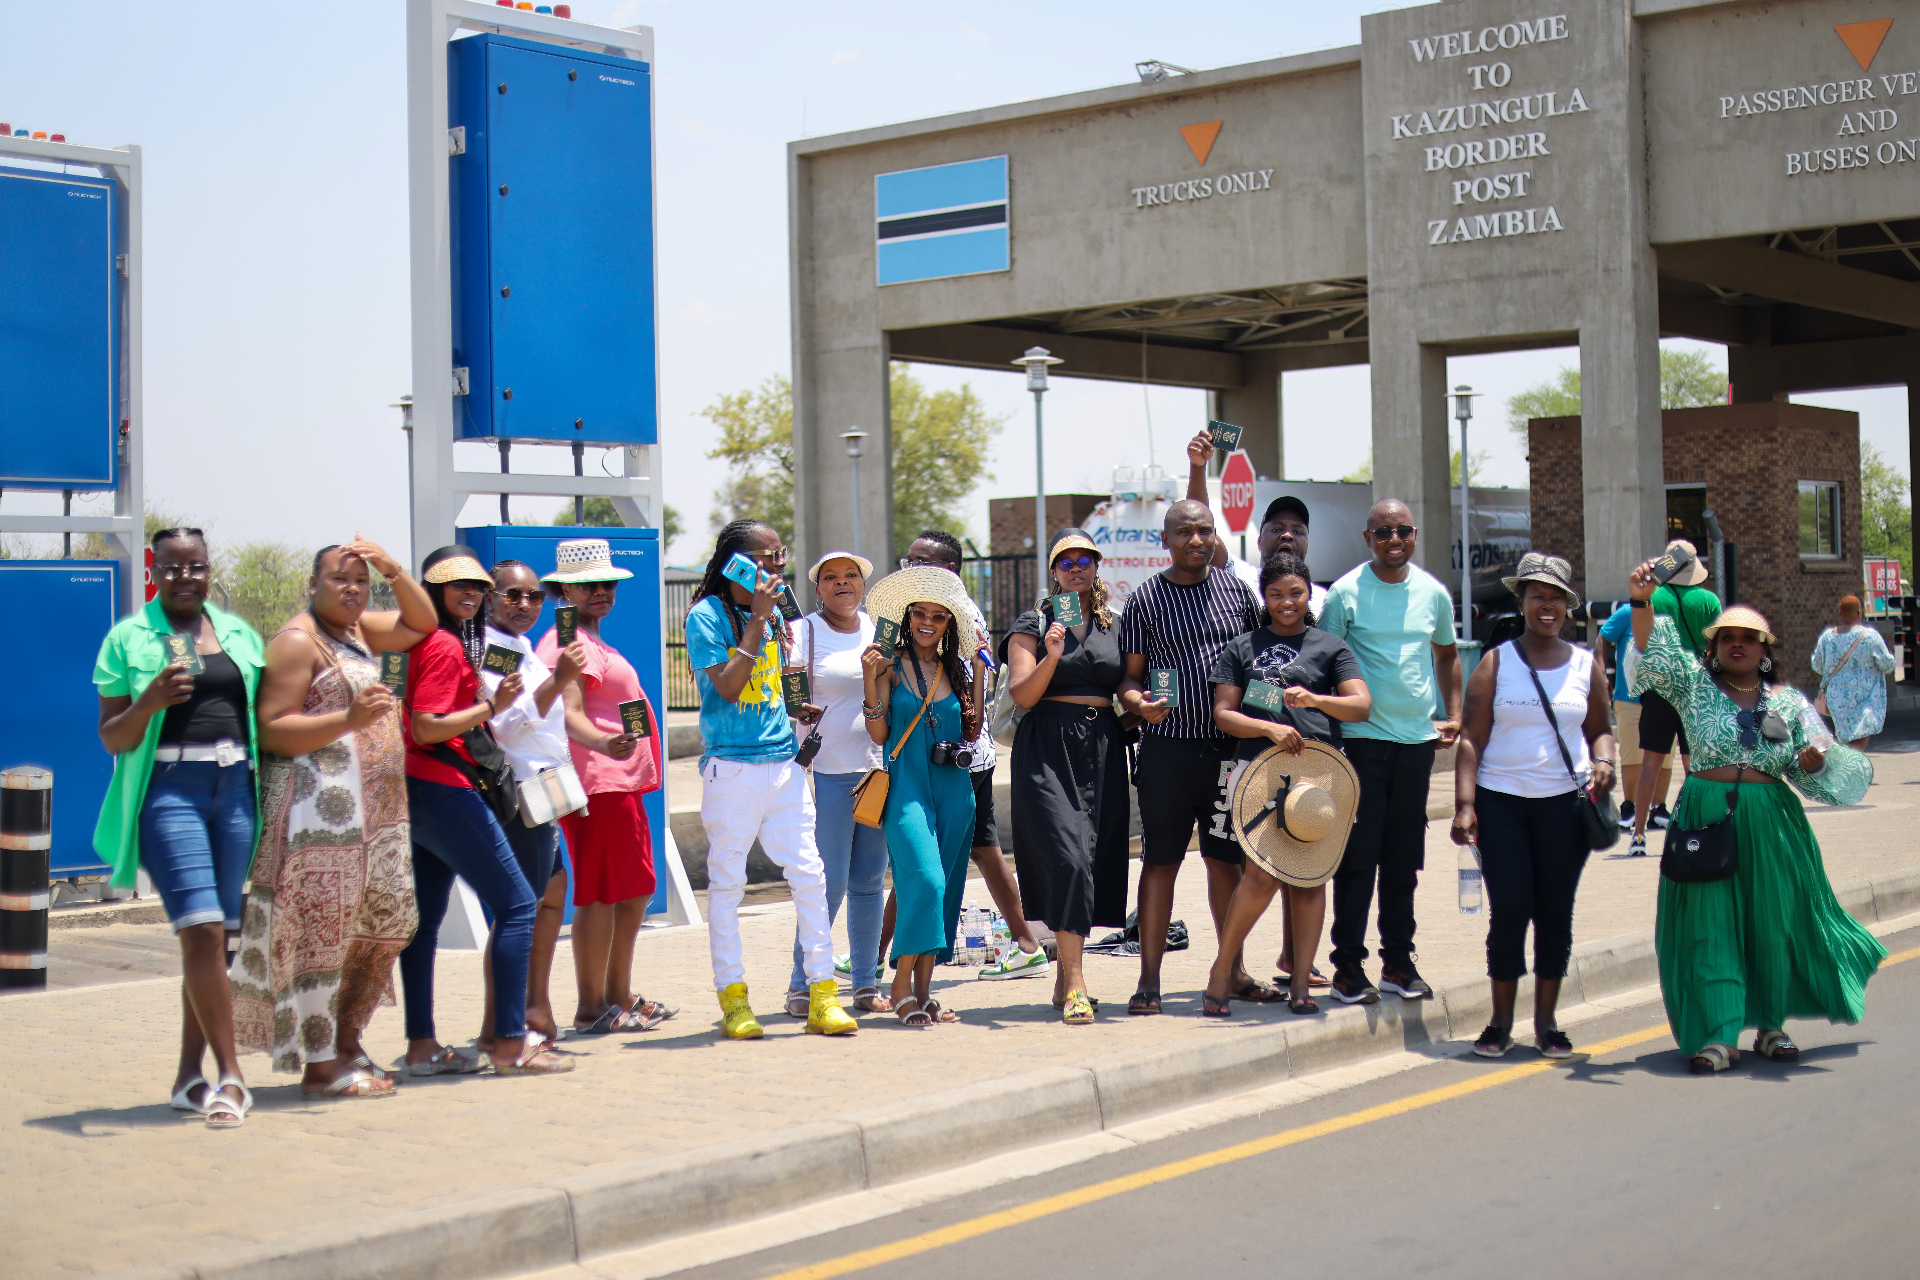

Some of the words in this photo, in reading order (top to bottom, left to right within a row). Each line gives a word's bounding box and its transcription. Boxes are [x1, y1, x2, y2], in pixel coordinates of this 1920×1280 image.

[1408, 14, 1569, 62] WELCOME
[606, 76, 635, 86] NUCTECH
[1467, 62, 1512, 90] TO
[1719, 78, 1876, 118] PASSENGER
[1880, 71, 1920, 97] VE
[1390, 87, 1590, 140] KAZUNGULA
[1837, 108, 1898, 136] AND
[1424, 131, 1551, 172] BORDER
[1785, 144, 1870, 175] BUSES
[1876, 138, 1920, 164] ON
[1131, 177, 1213, 208] TRUCKS
[1216, 168, 1275, 195] ONLY
[1452, 171, 1531, 205] POST
[1427, 206, 1565, 245] ZAMBIA
[1222, 482, 1253, 509] STOP
